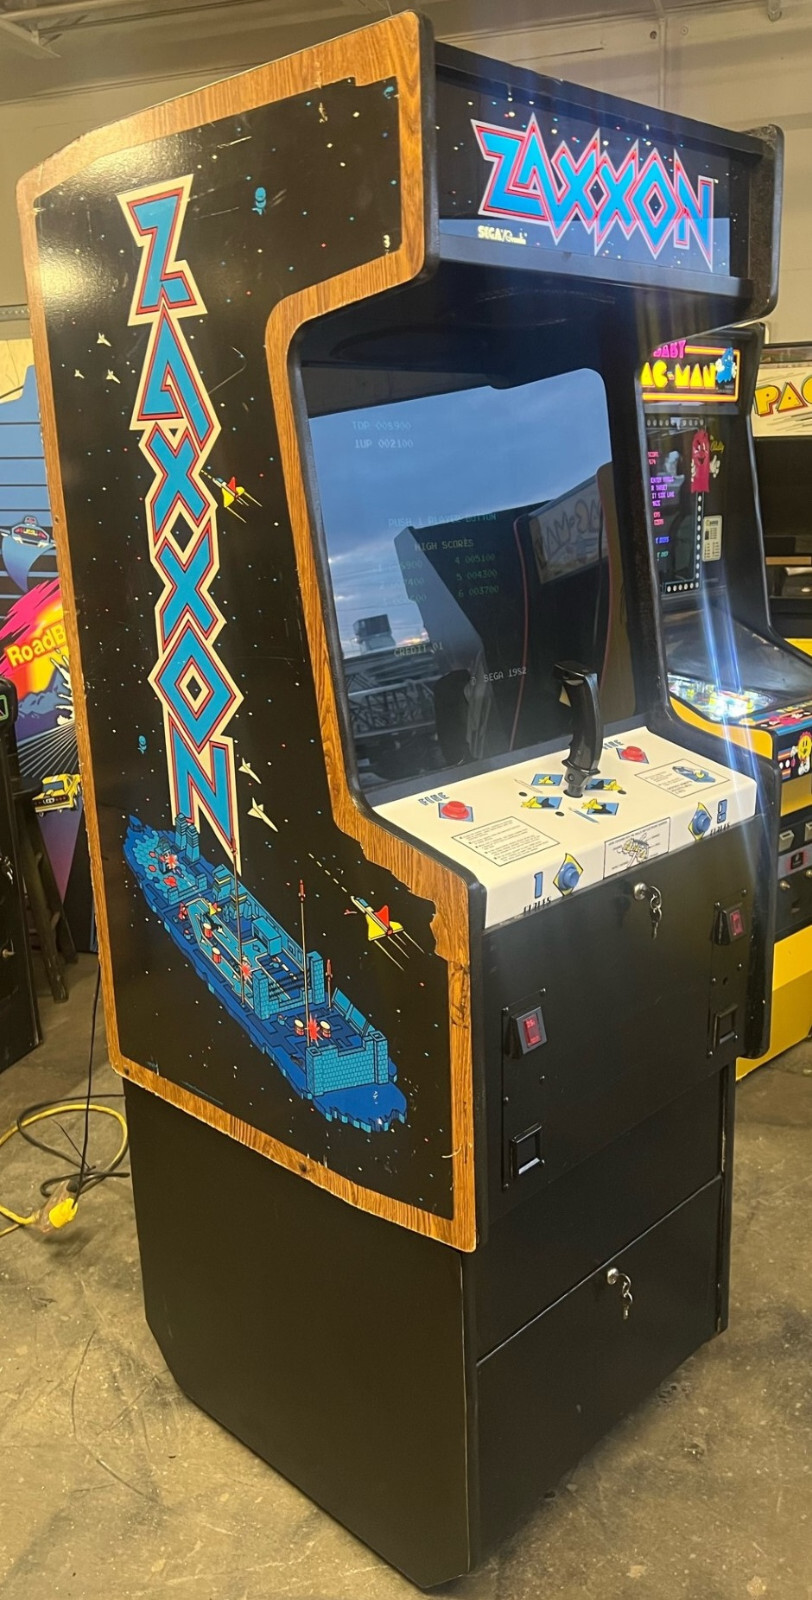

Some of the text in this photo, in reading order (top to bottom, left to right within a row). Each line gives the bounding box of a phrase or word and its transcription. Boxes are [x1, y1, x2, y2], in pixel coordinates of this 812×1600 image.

[470, 112, 714, 273] ZAXXON
[641, 360, 716, 390] AC-MAN
[354, 438, 414, 449] 1UP 002100
[116, 174, 244, 877] ZAXXON
[414, 538, 474, 552] HIGH SCORES
[393, 643, 427, 657] CREDIT
[483, 671, 504, 682] SEGA
[533, 871, 544, 899] 1
